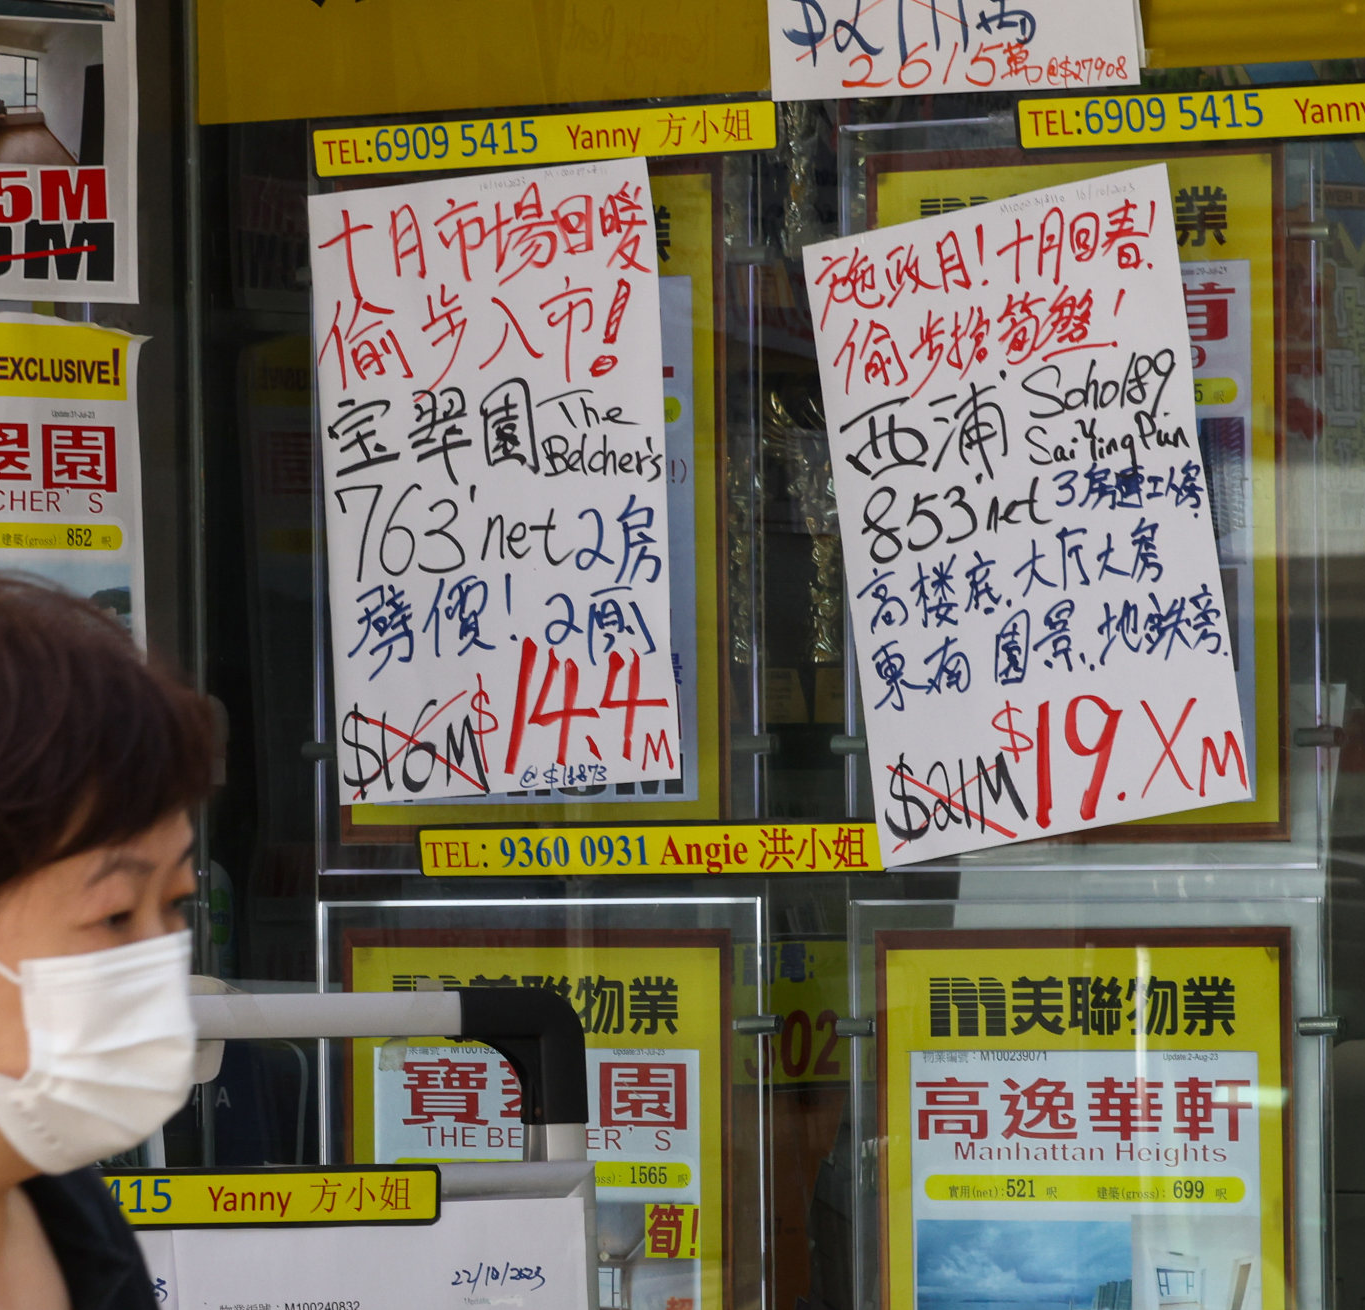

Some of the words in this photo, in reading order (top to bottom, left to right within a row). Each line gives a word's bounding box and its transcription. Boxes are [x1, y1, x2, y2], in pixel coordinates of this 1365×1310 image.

[1178, 93, 1265, 128] 5415
[461, 119, 538, 156] 5415
[566, 122, 641, 153] Yanny
[657, 111, 753, 149] 方小姐
[542, 433, 663, 479] Belcher's
[65, 528, 93, 548] 852
[480, 508, 572, 567] net
[499, 837, 571, 868] 9360
[579, 834, 649, 867] 0931
[661, 834, 748, 874] Angie
[758, 828, 868, 869] 洪小姐
[1011, 977, 1235, 1037] 美聯物業
[916, 1078, 1252, 1141] 高逸華軒
[629, 1164, 668, 1187] 1565
[954, 1141, 1104, 1162] Manhattan
[1116, 1142, 1227, 1167] Heights
[1006, 1180, 1035, 1198] 521
[1173, 1181, 1204, 1199] 699
